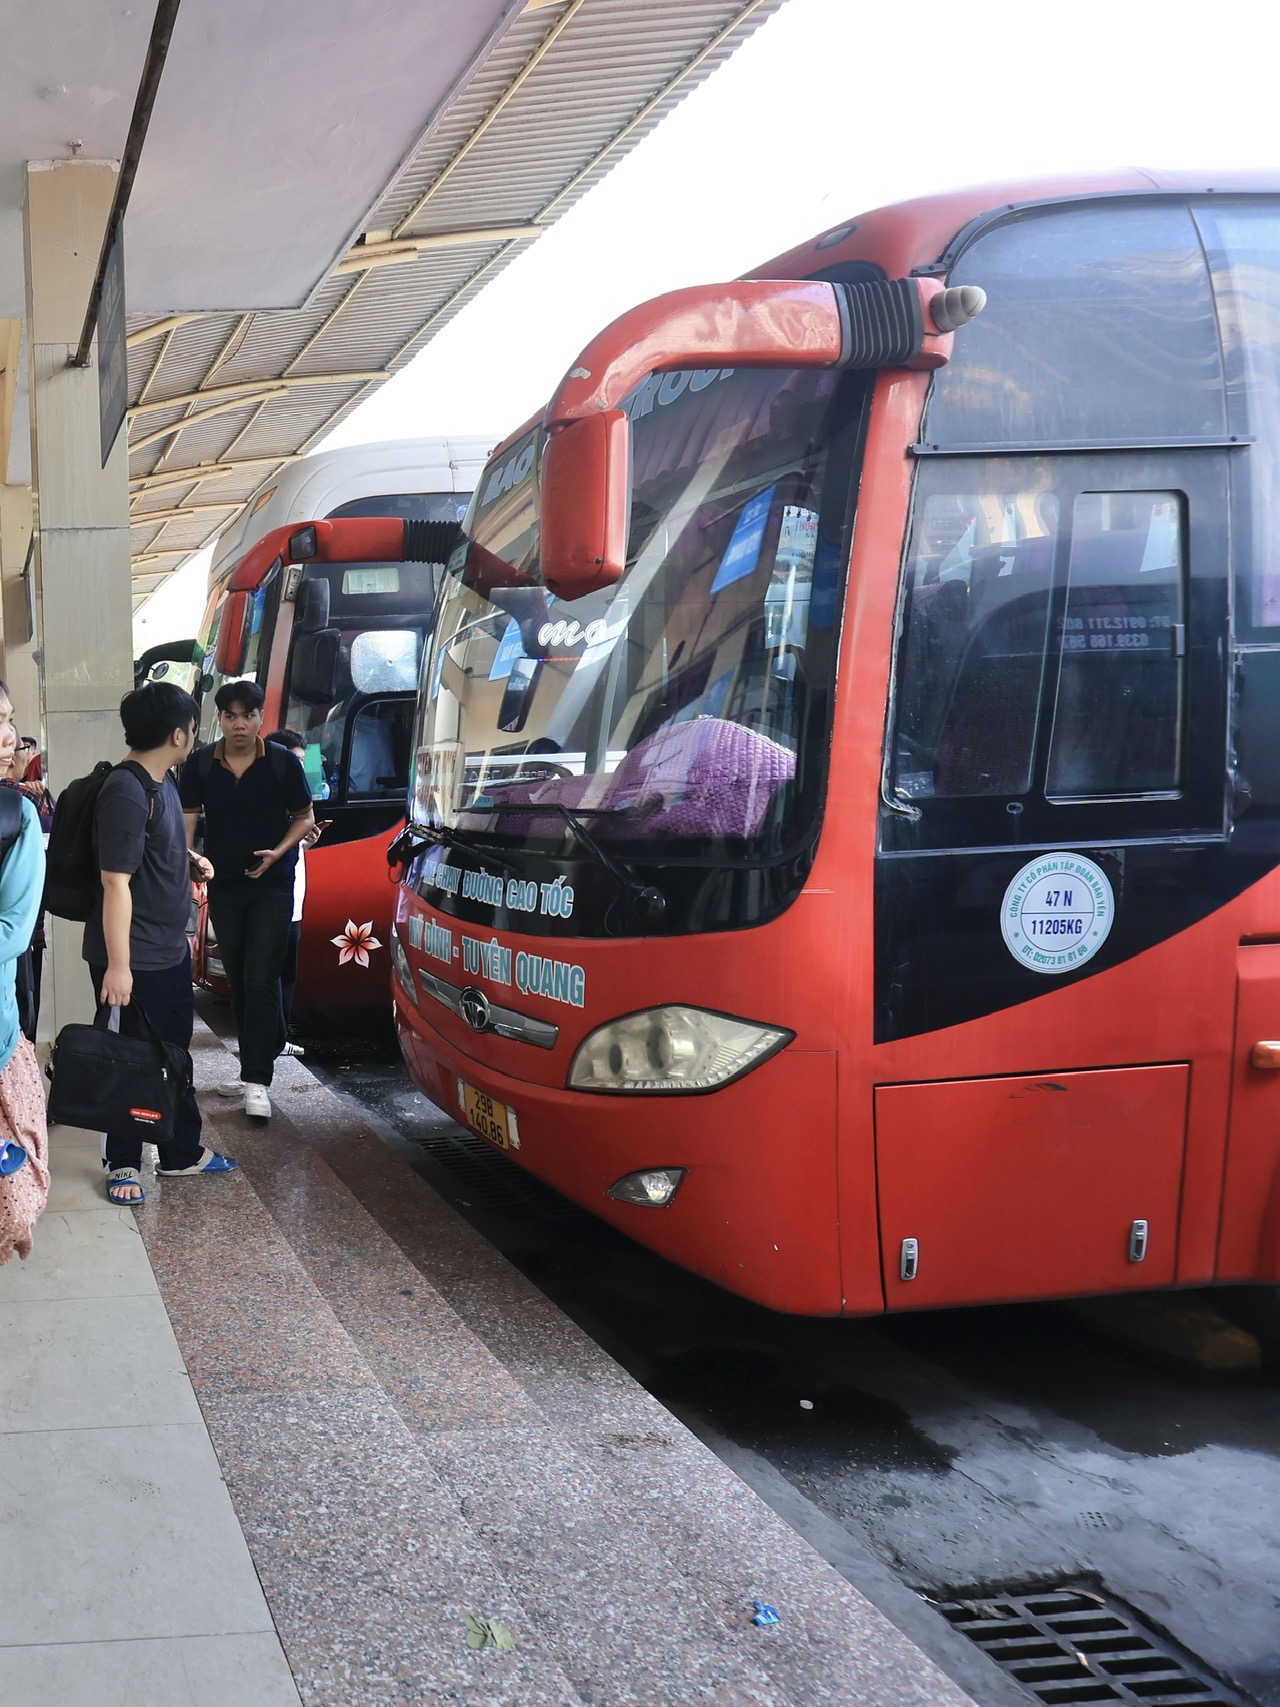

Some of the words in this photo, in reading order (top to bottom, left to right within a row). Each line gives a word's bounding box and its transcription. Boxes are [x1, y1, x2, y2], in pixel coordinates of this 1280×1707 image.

[435, 863, 462, 898] CHẠY
[506, 879, 538, 912] CAO
[540, 875, 575, 919] TỐC
[1017, 882, 1028, 893] TY
[1045, 891, 1060, 907] 47
[1063, 890, 1073, 907] N
[1031, 919, 1083, 935] 11205KG
[409, 914, 424, 950] MỸ
[424, 918, 452, 965] ĐÌNH
[516, 951, 586, 1008] QUANG
[474, 1090, 494, 1118] 29B
